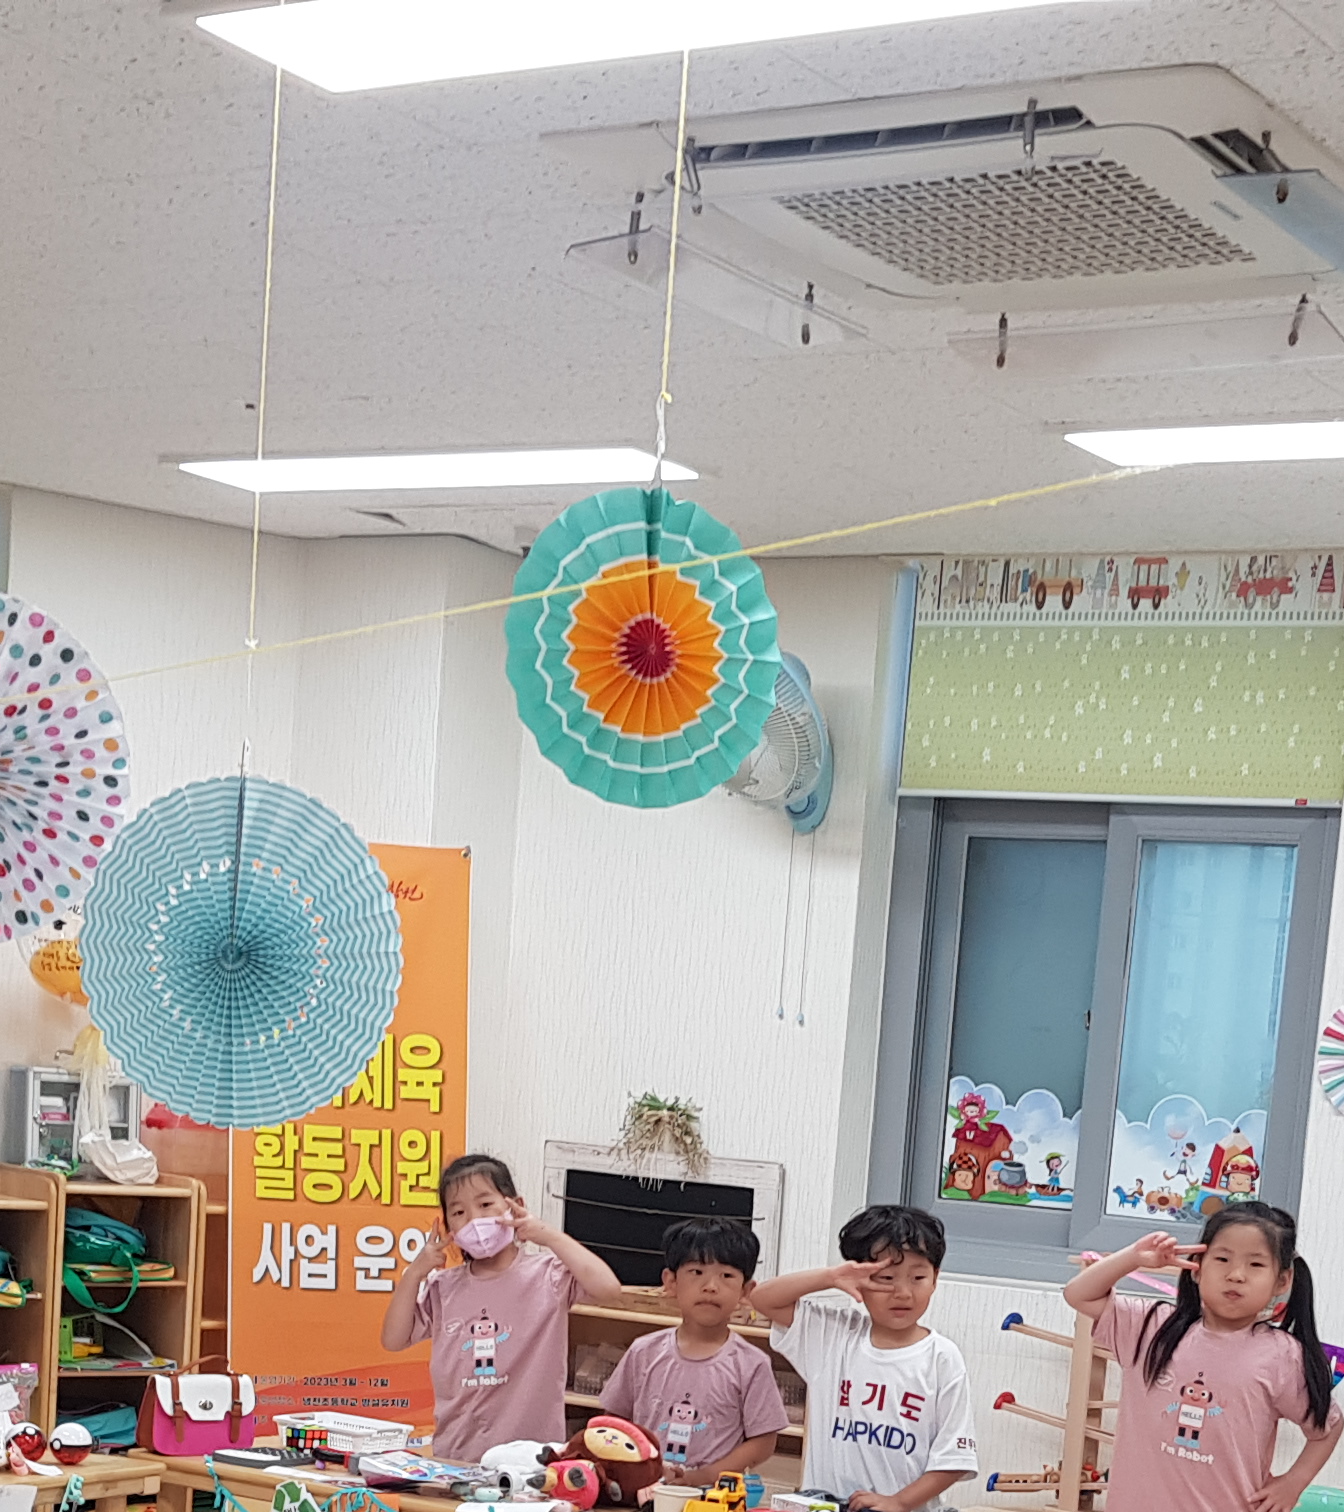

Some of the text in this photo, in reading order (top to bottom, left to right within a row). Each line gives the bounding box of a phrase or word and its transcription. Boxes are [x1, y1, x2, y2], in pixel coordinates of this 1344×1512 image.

[253, 1122, 443, 1208] 활동지원
[253, 1222, 337, 1290] 사업
[303, 1376, 339, 1387] 2023년
[831, 1416, 917, 1456] HAPKIDO
[1177, 1446, 1215, 1465] Robot
